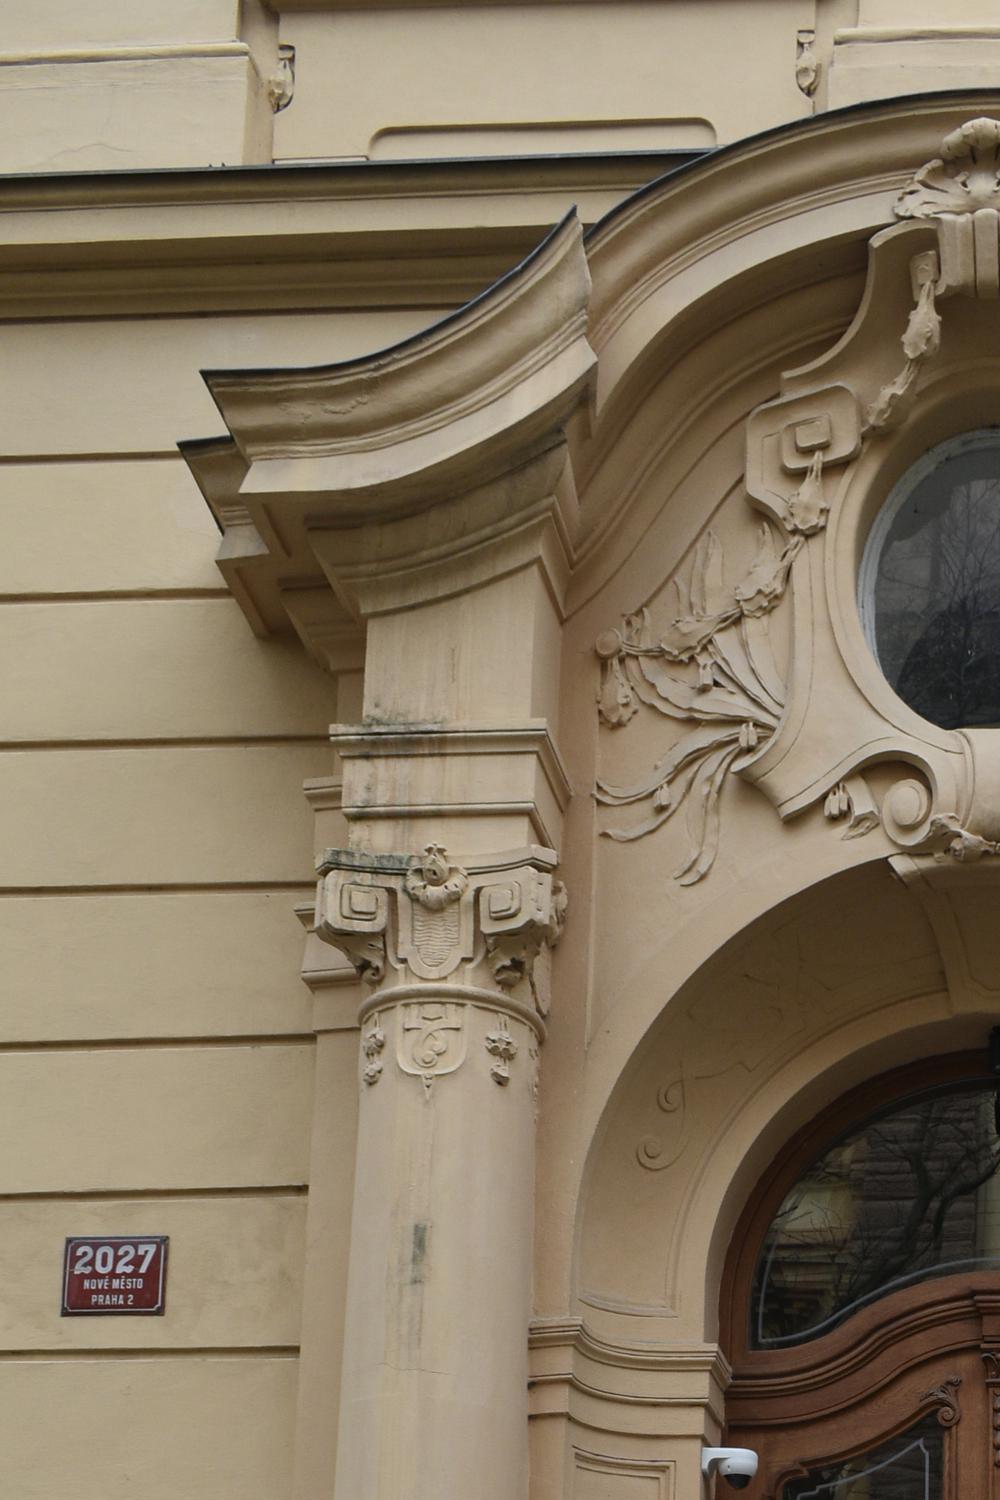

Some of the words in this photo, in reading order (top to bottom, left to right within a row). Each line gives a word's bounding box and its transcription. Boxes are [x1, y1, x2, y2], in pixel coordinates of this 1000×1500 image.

[73, 1244, 157, 1275] 2027
[83, 1276, 110, 1290] NOVÉ
[112, 1275, 144, 1290] MĚSTO
[91, 1294, 124, 1305] PRAHA
[127, 1294, 134, 1305] 2
